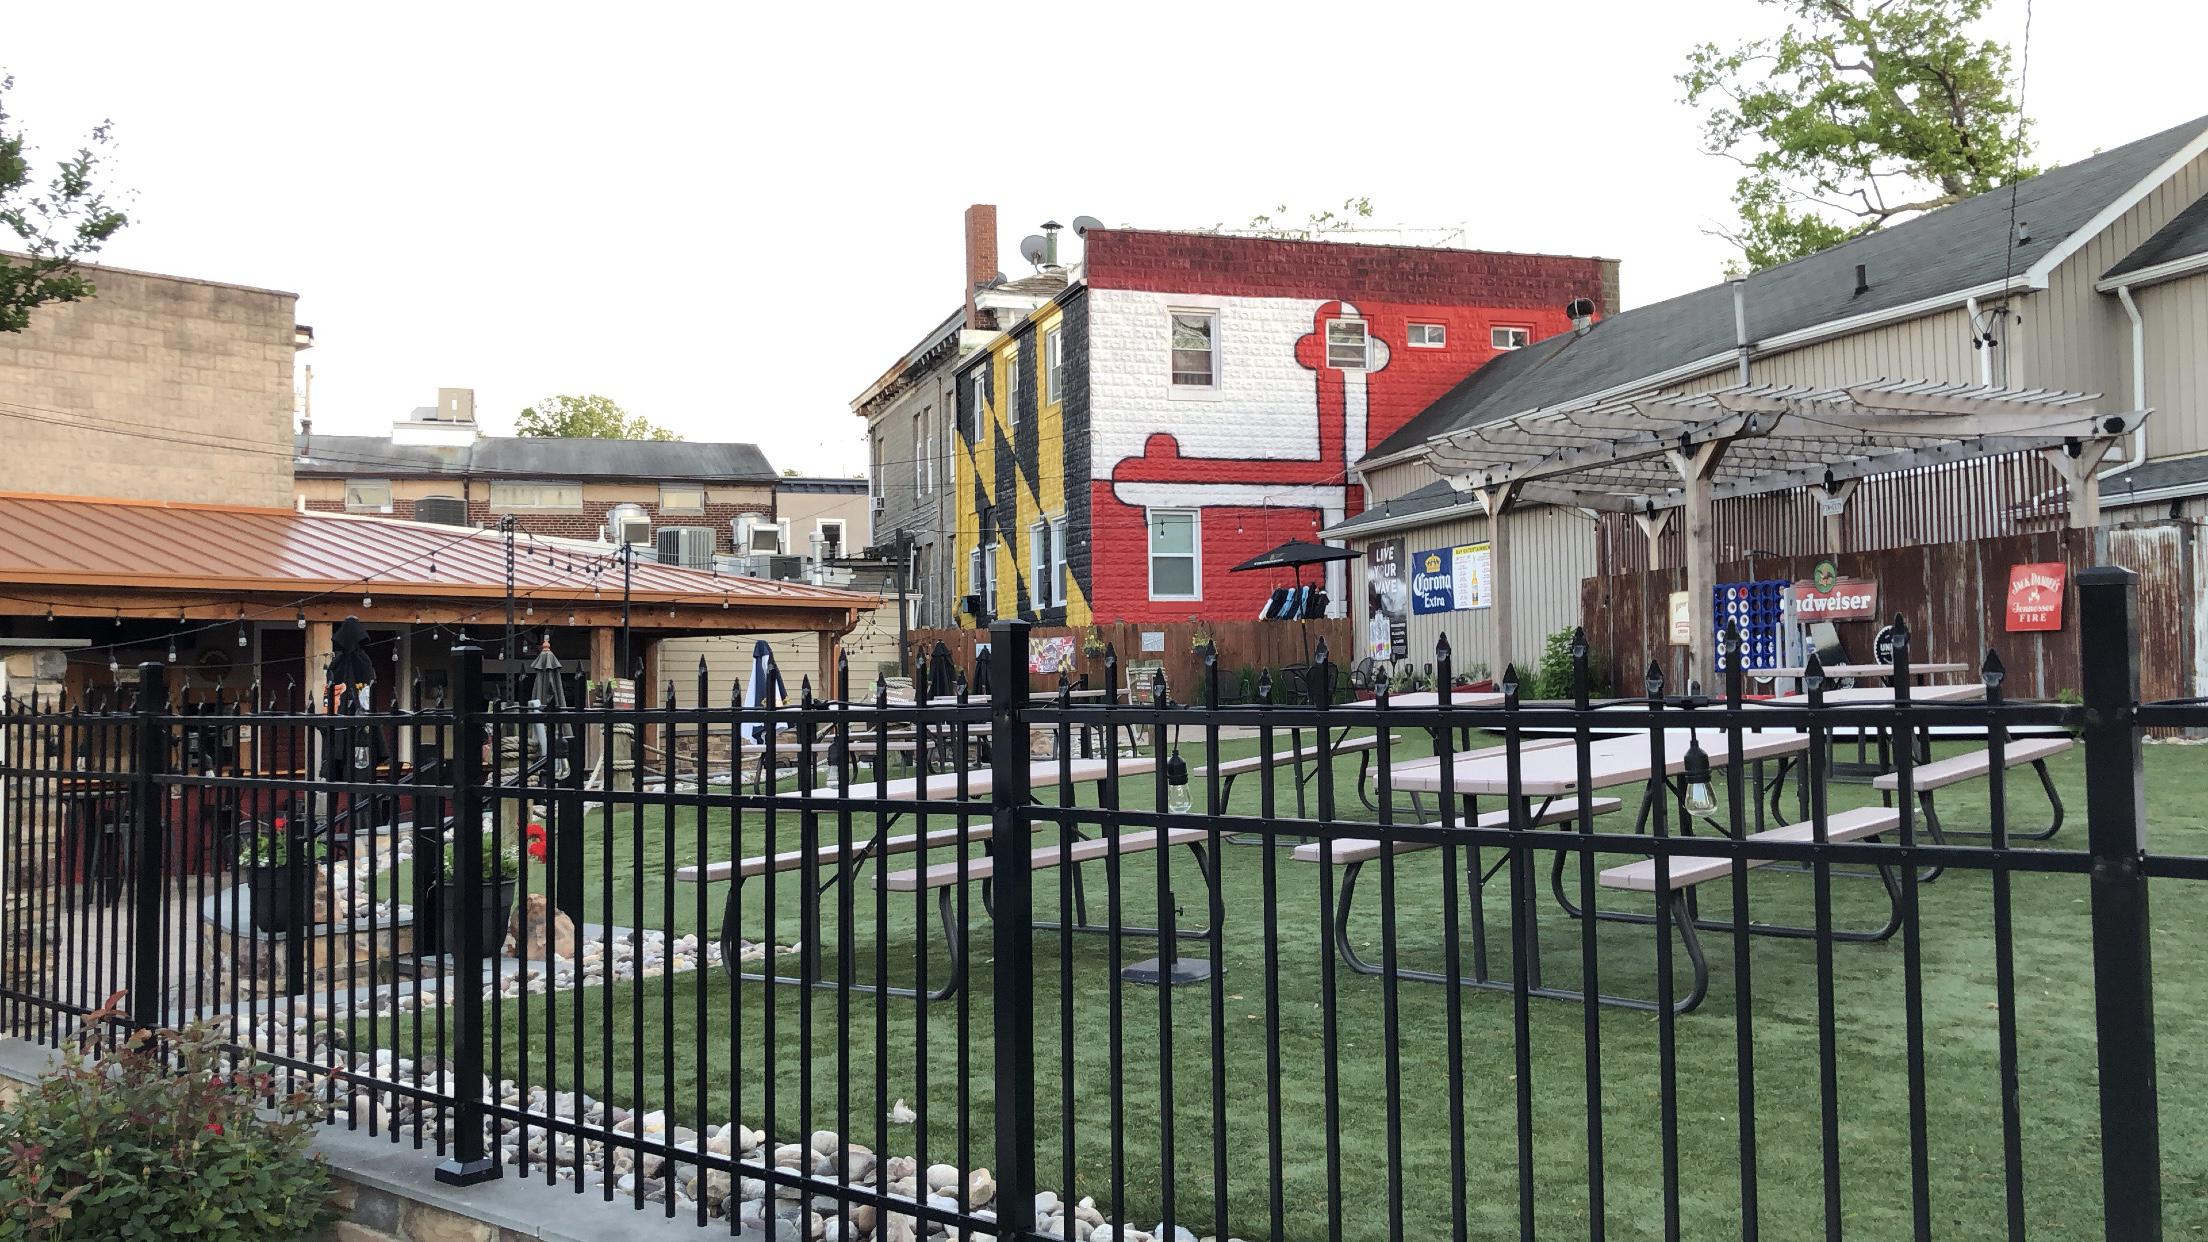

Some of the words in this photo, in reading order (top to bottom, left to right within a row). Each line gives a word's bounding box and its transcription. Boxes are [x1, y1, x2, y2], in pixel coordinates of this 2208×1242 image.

[1376, 546, 1395, 562] LIVE
[1374, 579, 1397, 594] WAVE
[1413, 572, 1452, 598] Corona
[1424, 592, 1446, 608] Extra
[1780, 591, 1871, 612] dweiser
[2019, 612, 2047, 622] FIRE
